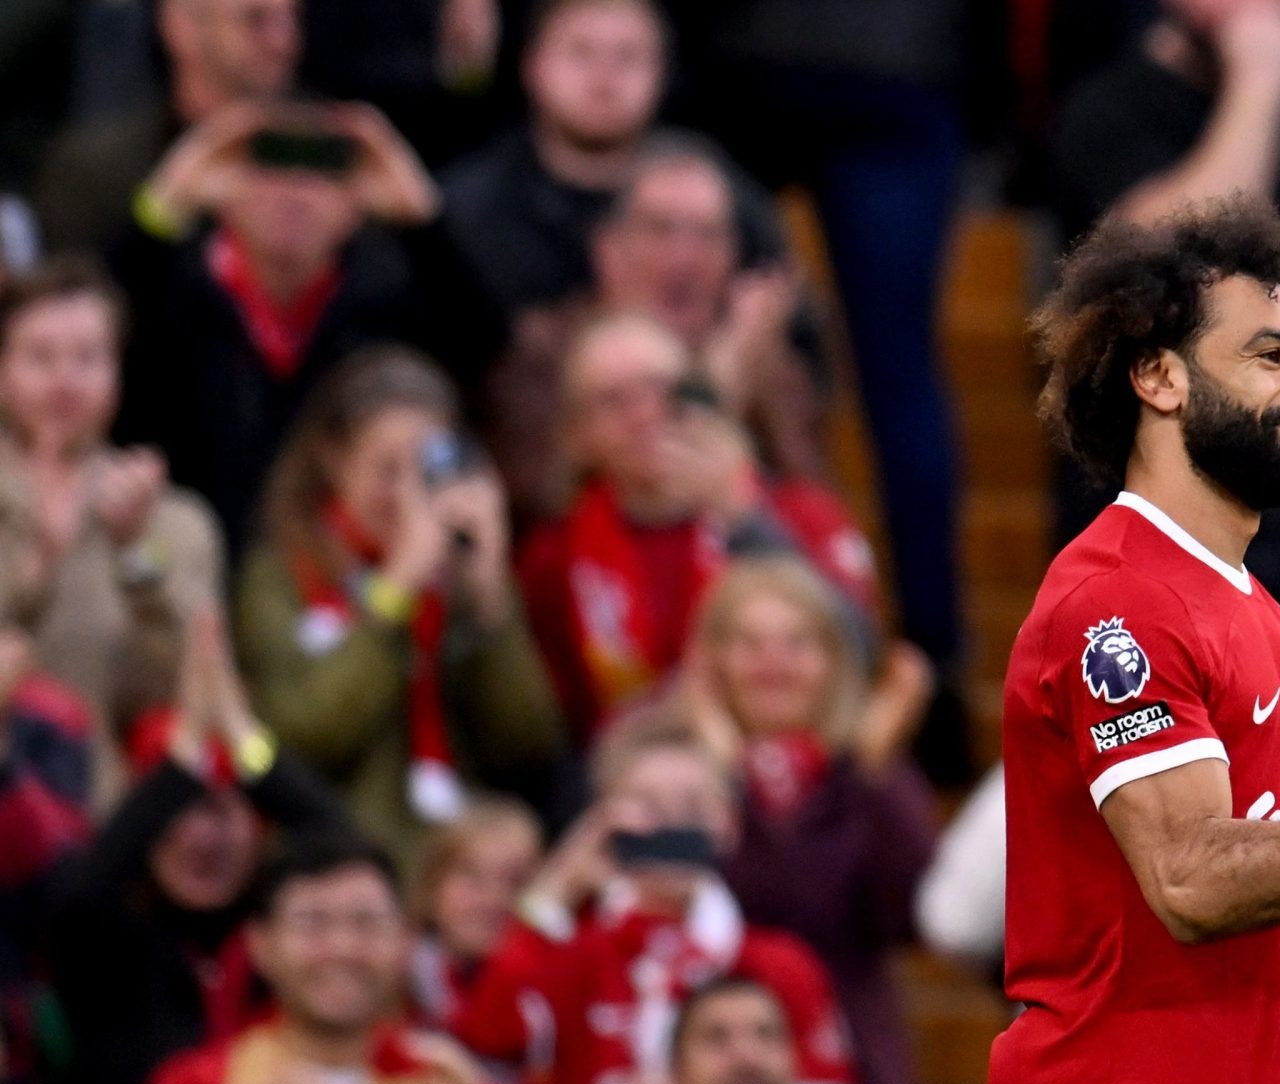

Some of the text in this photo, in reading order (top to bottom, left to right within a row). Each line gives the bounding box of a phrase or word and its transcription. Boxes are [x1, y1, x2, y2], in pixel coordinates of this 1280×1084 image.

[1090, 705, 1162, 740] No room
[1121, 715, 1175, 745] racism
